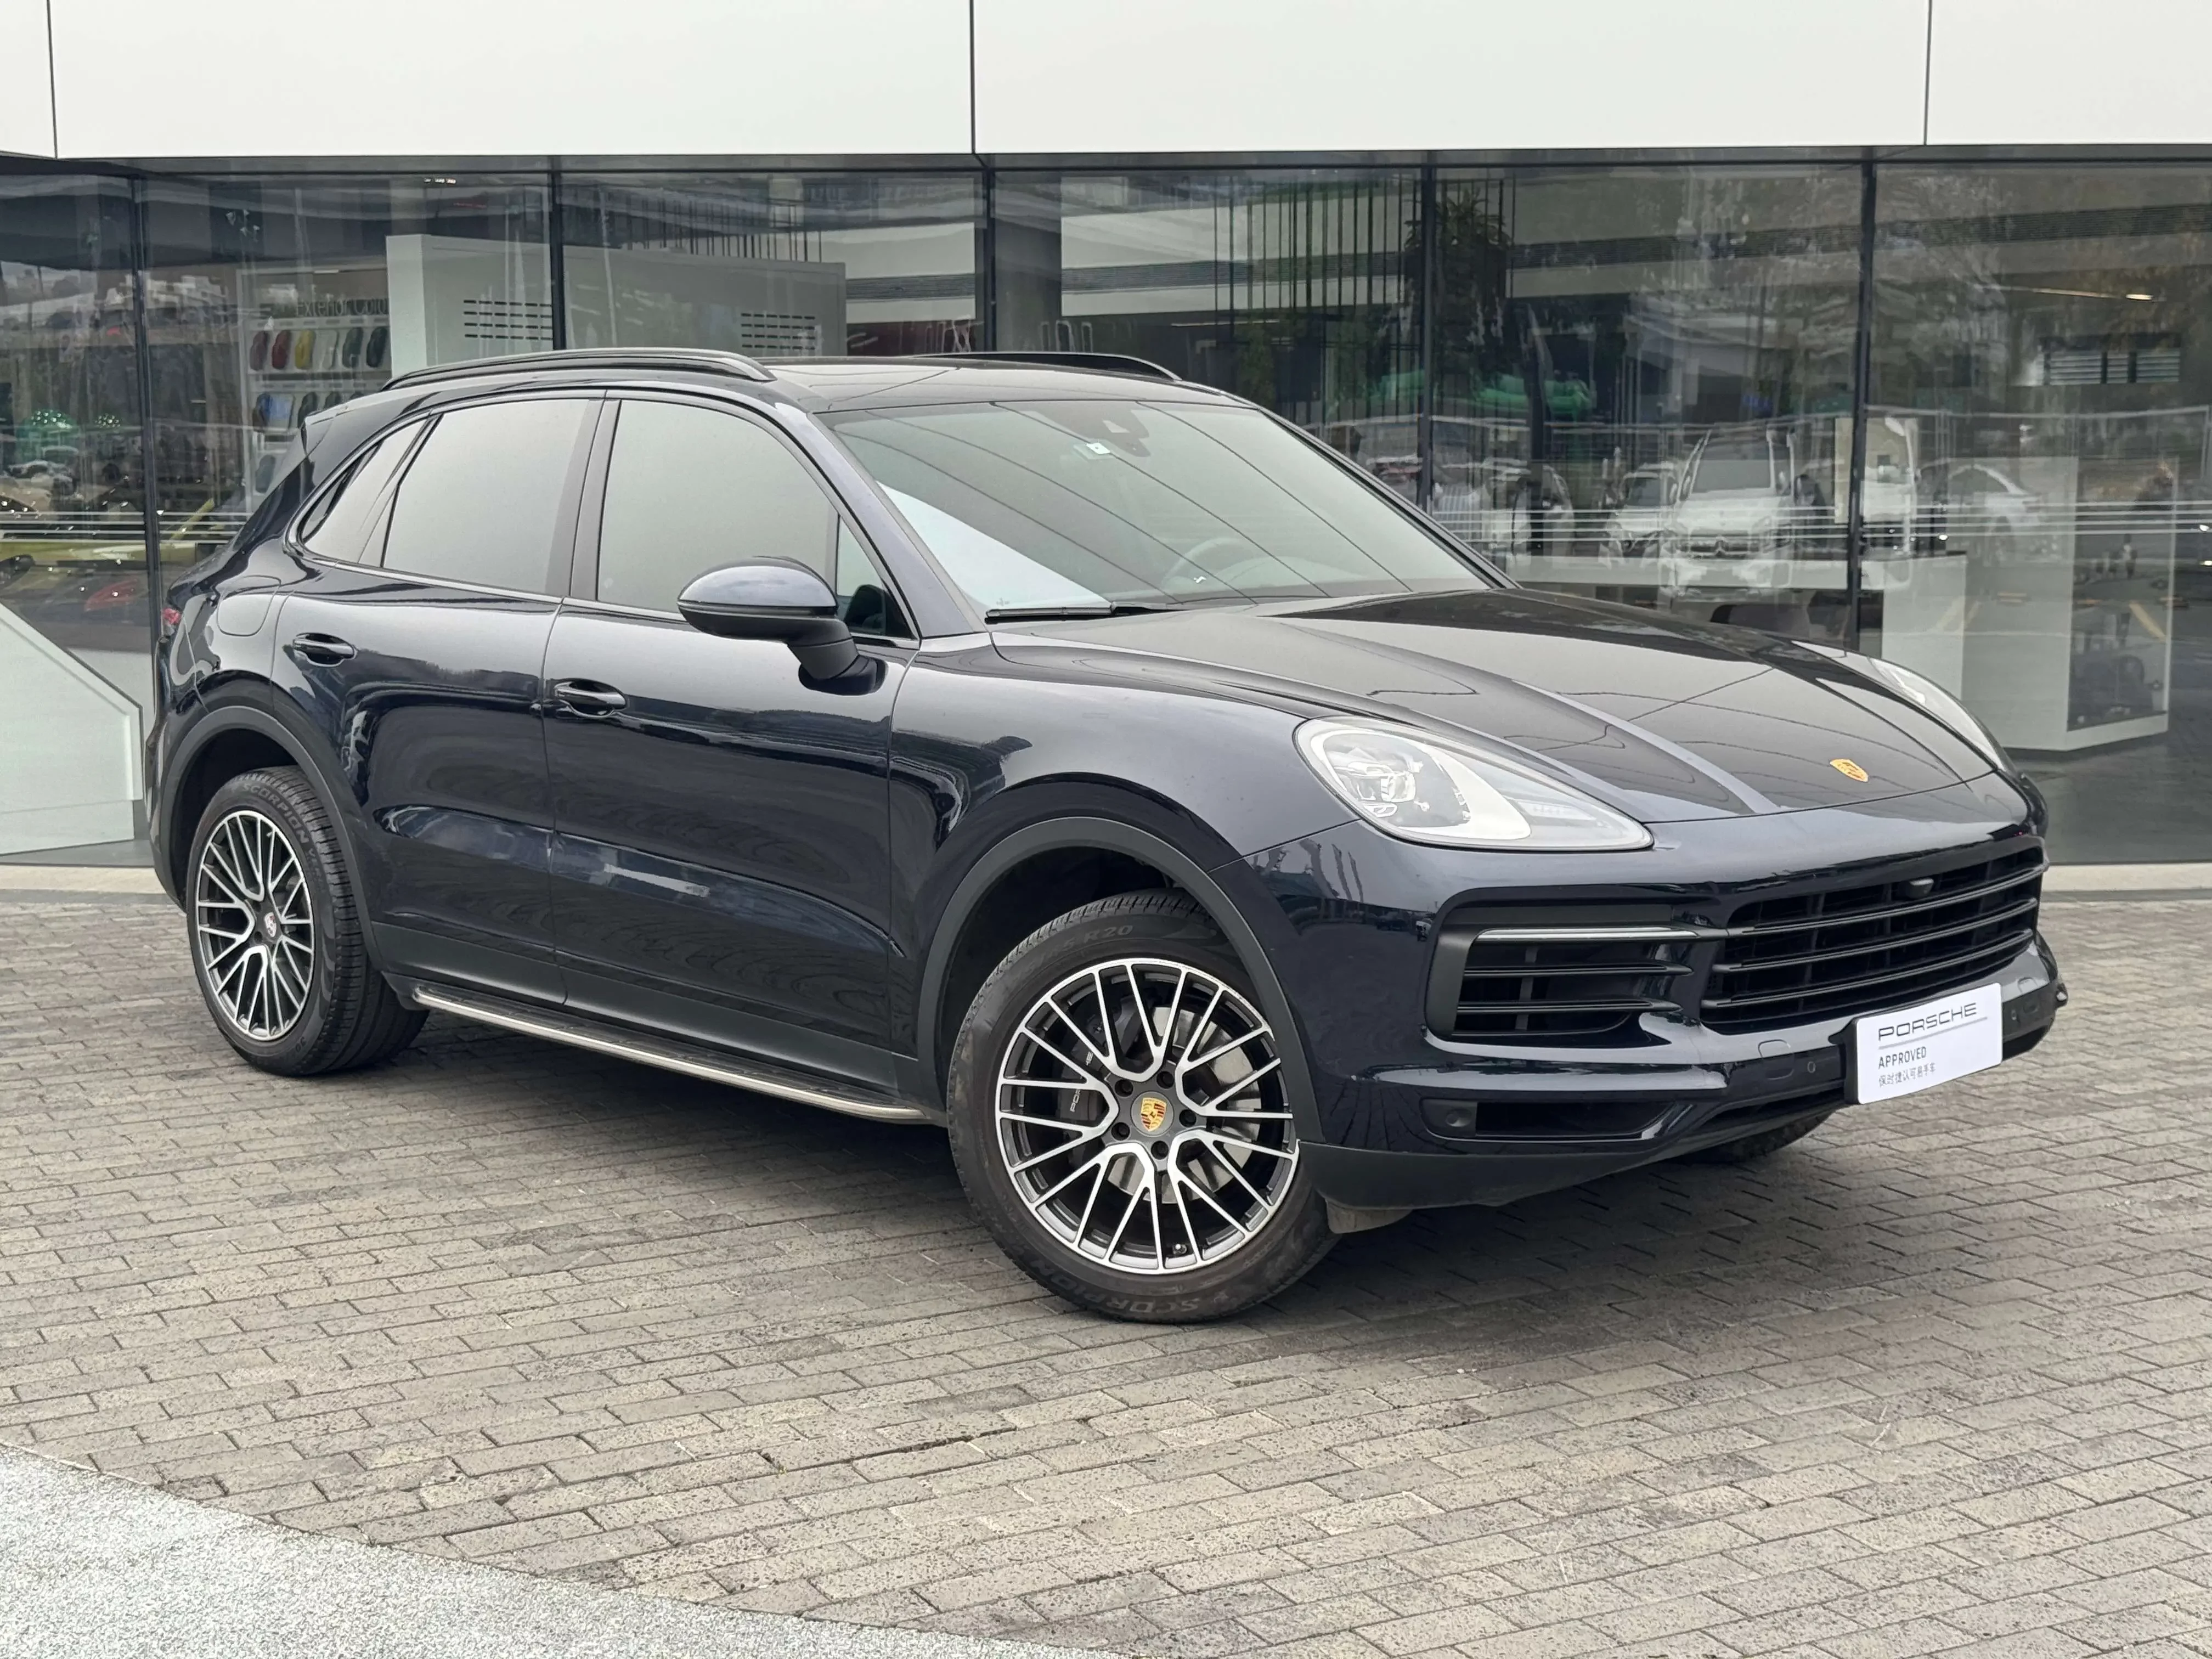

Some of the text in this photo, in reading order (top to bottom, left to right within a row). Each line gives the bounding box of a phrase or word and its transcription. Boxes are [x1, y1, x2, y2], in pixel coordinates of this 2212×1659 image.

[243, 783, 309, 844] SCORPION
[1878, 1002, 1977, 1041] PORSCHE
[1878, 1046, 1926, 1069] APPROVED
